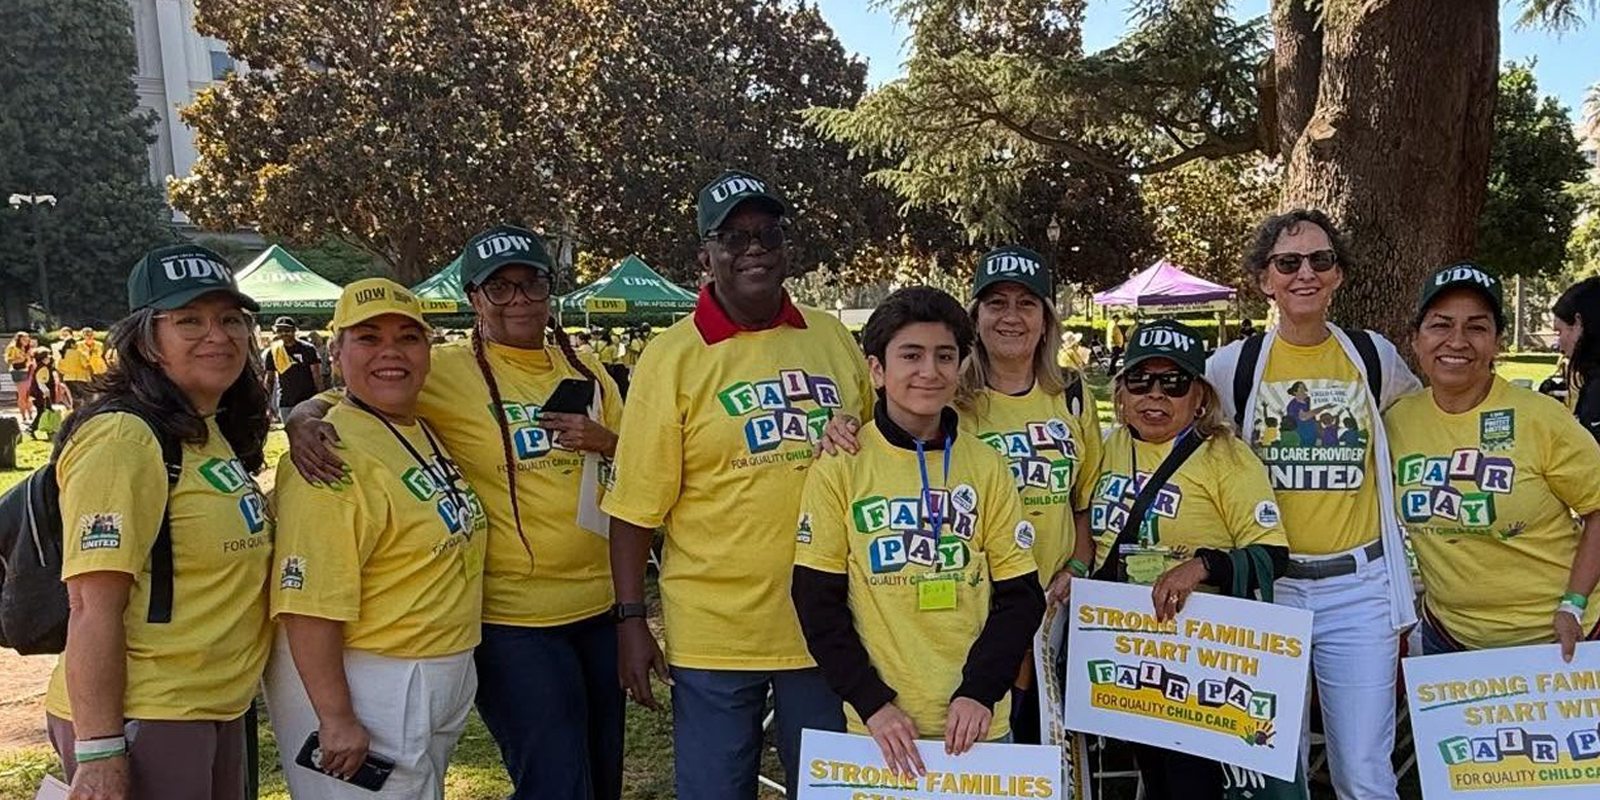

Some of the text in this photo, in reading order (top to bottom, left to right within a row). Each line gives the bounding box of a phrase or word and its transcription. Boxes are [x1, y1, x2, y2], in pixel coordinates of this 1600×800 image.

[711, 178, 765, 203] UDW
[477, 235, 532, 259] UDW
[162, 258, 232, 283] UDW
[986, 255, 1040, 276] UDW
[1435, 268, 1496, 287] UDW
[622, 277, 661, 287] UDW
[355, 287, 385, 305] UDW
[594, 301, 619, 309] UDW
[1139, 330, 1196, 352] UDW
[732, 372, 840, 411] FAIR
[755, 414, 826, 441] PAY
[731, 448, 814, 470] FOR QUALITY CHILD
[1280, 448, 1310, 461] CARE
[1266, 465, 1364, 489] NITED
[1407, 452, 1508, 490] FAIR
[1024, 495, 1052, 505] CHILD
[1410, 494, 1484, 524] PAY
[864, 492, 974, 539] FAIR
[223, 538, 247, 553] FOR
[882, 539, 963, 568] PAY
[869, 574, 909, 586] QUALITY
[1078, 604, 1303, 658] STRONG FAMILIES
[1114, 635, 1259, 677] START WITH
[1098, 664, 1269, 717] FAIR PAY
[1417, 676, 1528, 702] STRONG
[1096, 692, 1237, 731] FOR QUALITY CHILD CARE
[1464, 702, 1548, 726] START
[1451, 731, 1555, 761] FAIR
[925, 772, 1053, 799] FAMILIES
[1455, 772, 1481, 786] FOR
[1482, 769, 1535, 785] QUALITY
[1538, 767, 1582, 781] CHILD
